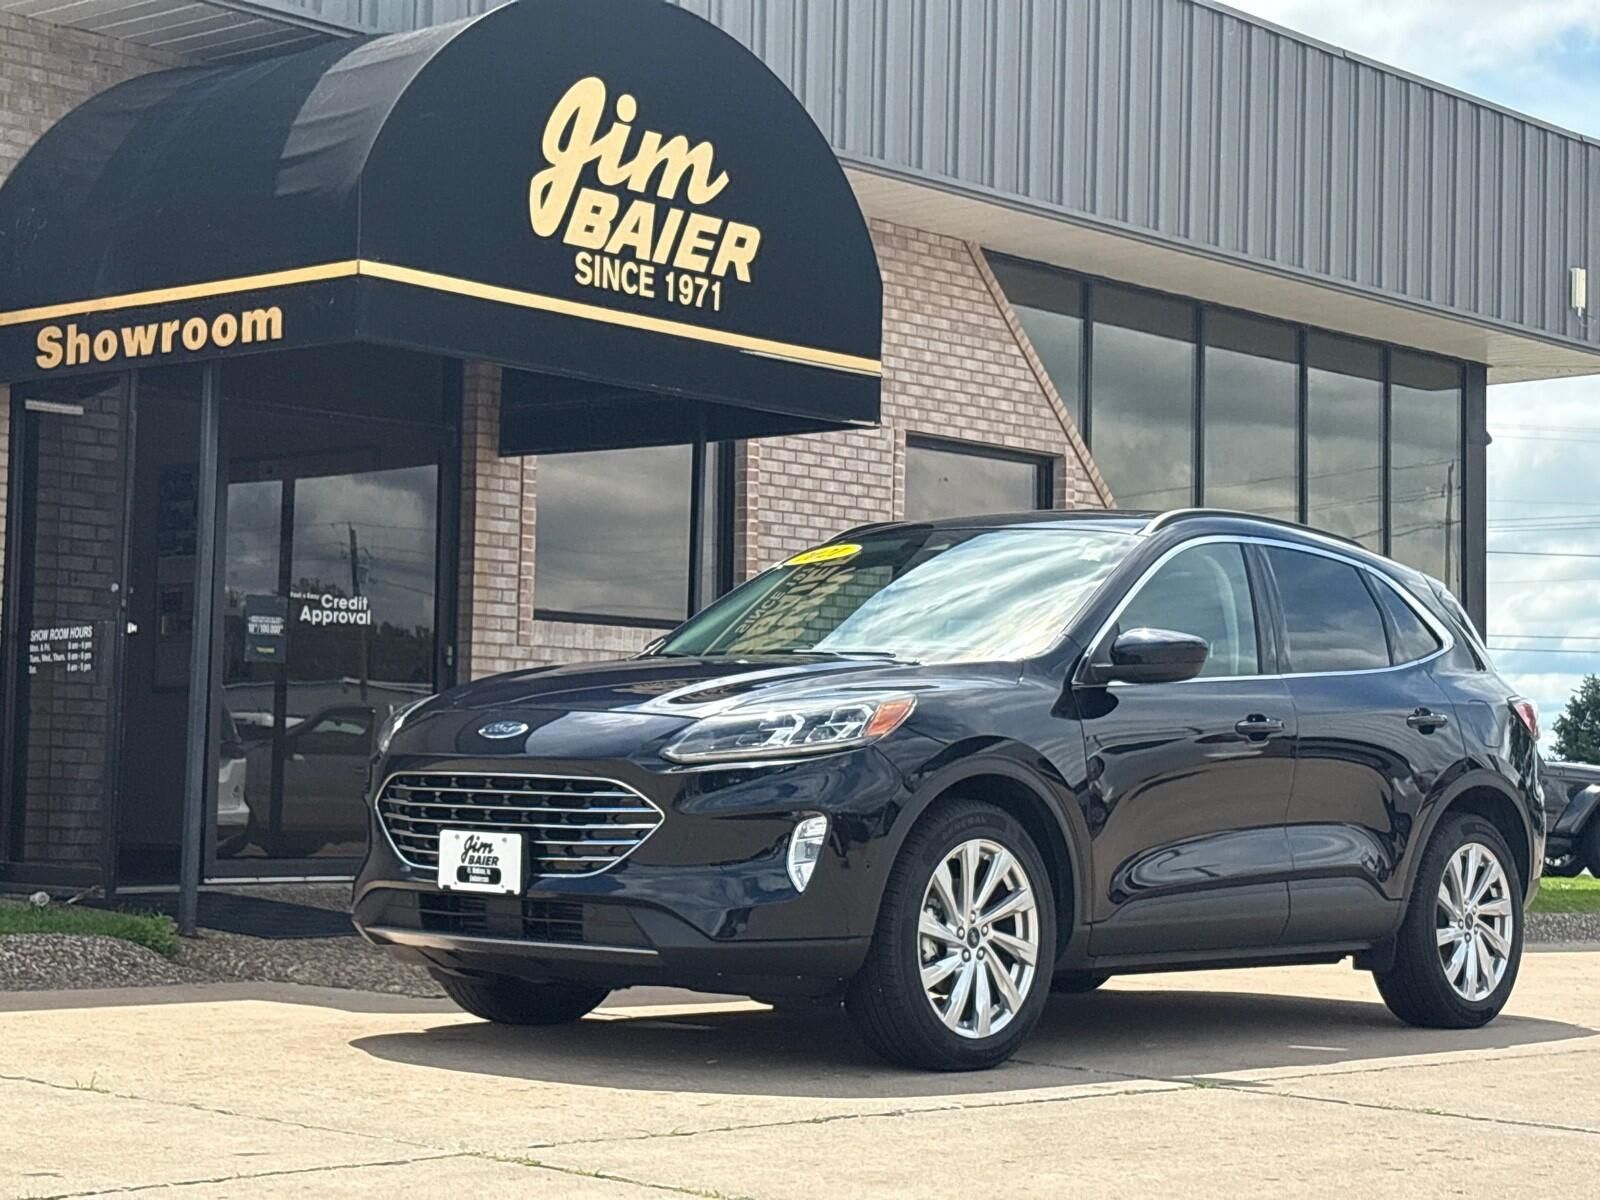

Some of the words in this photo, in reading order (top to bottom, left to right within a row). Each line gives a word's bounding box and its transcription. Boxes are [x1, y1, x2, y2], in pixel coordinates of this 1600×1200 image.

[529, 76, 730, 238] Jim
[562, 187, 762, 283] BAIER
[574, 251, 656, 299] SINCE
[665, 271, 722, 312] 1971
[35, 305, 284, 369] Showroom
[299, 605, 372, 626] Approval
[320, 593, 369, 611] Credit
[30, 629, 49, 642] SHOW
[49, 627, 69, 640] ROOM
[69, 625, 93, 639] HOURS
[460, 834, 495, 864] Jim
[467, 855, 500, 867] BAIER
